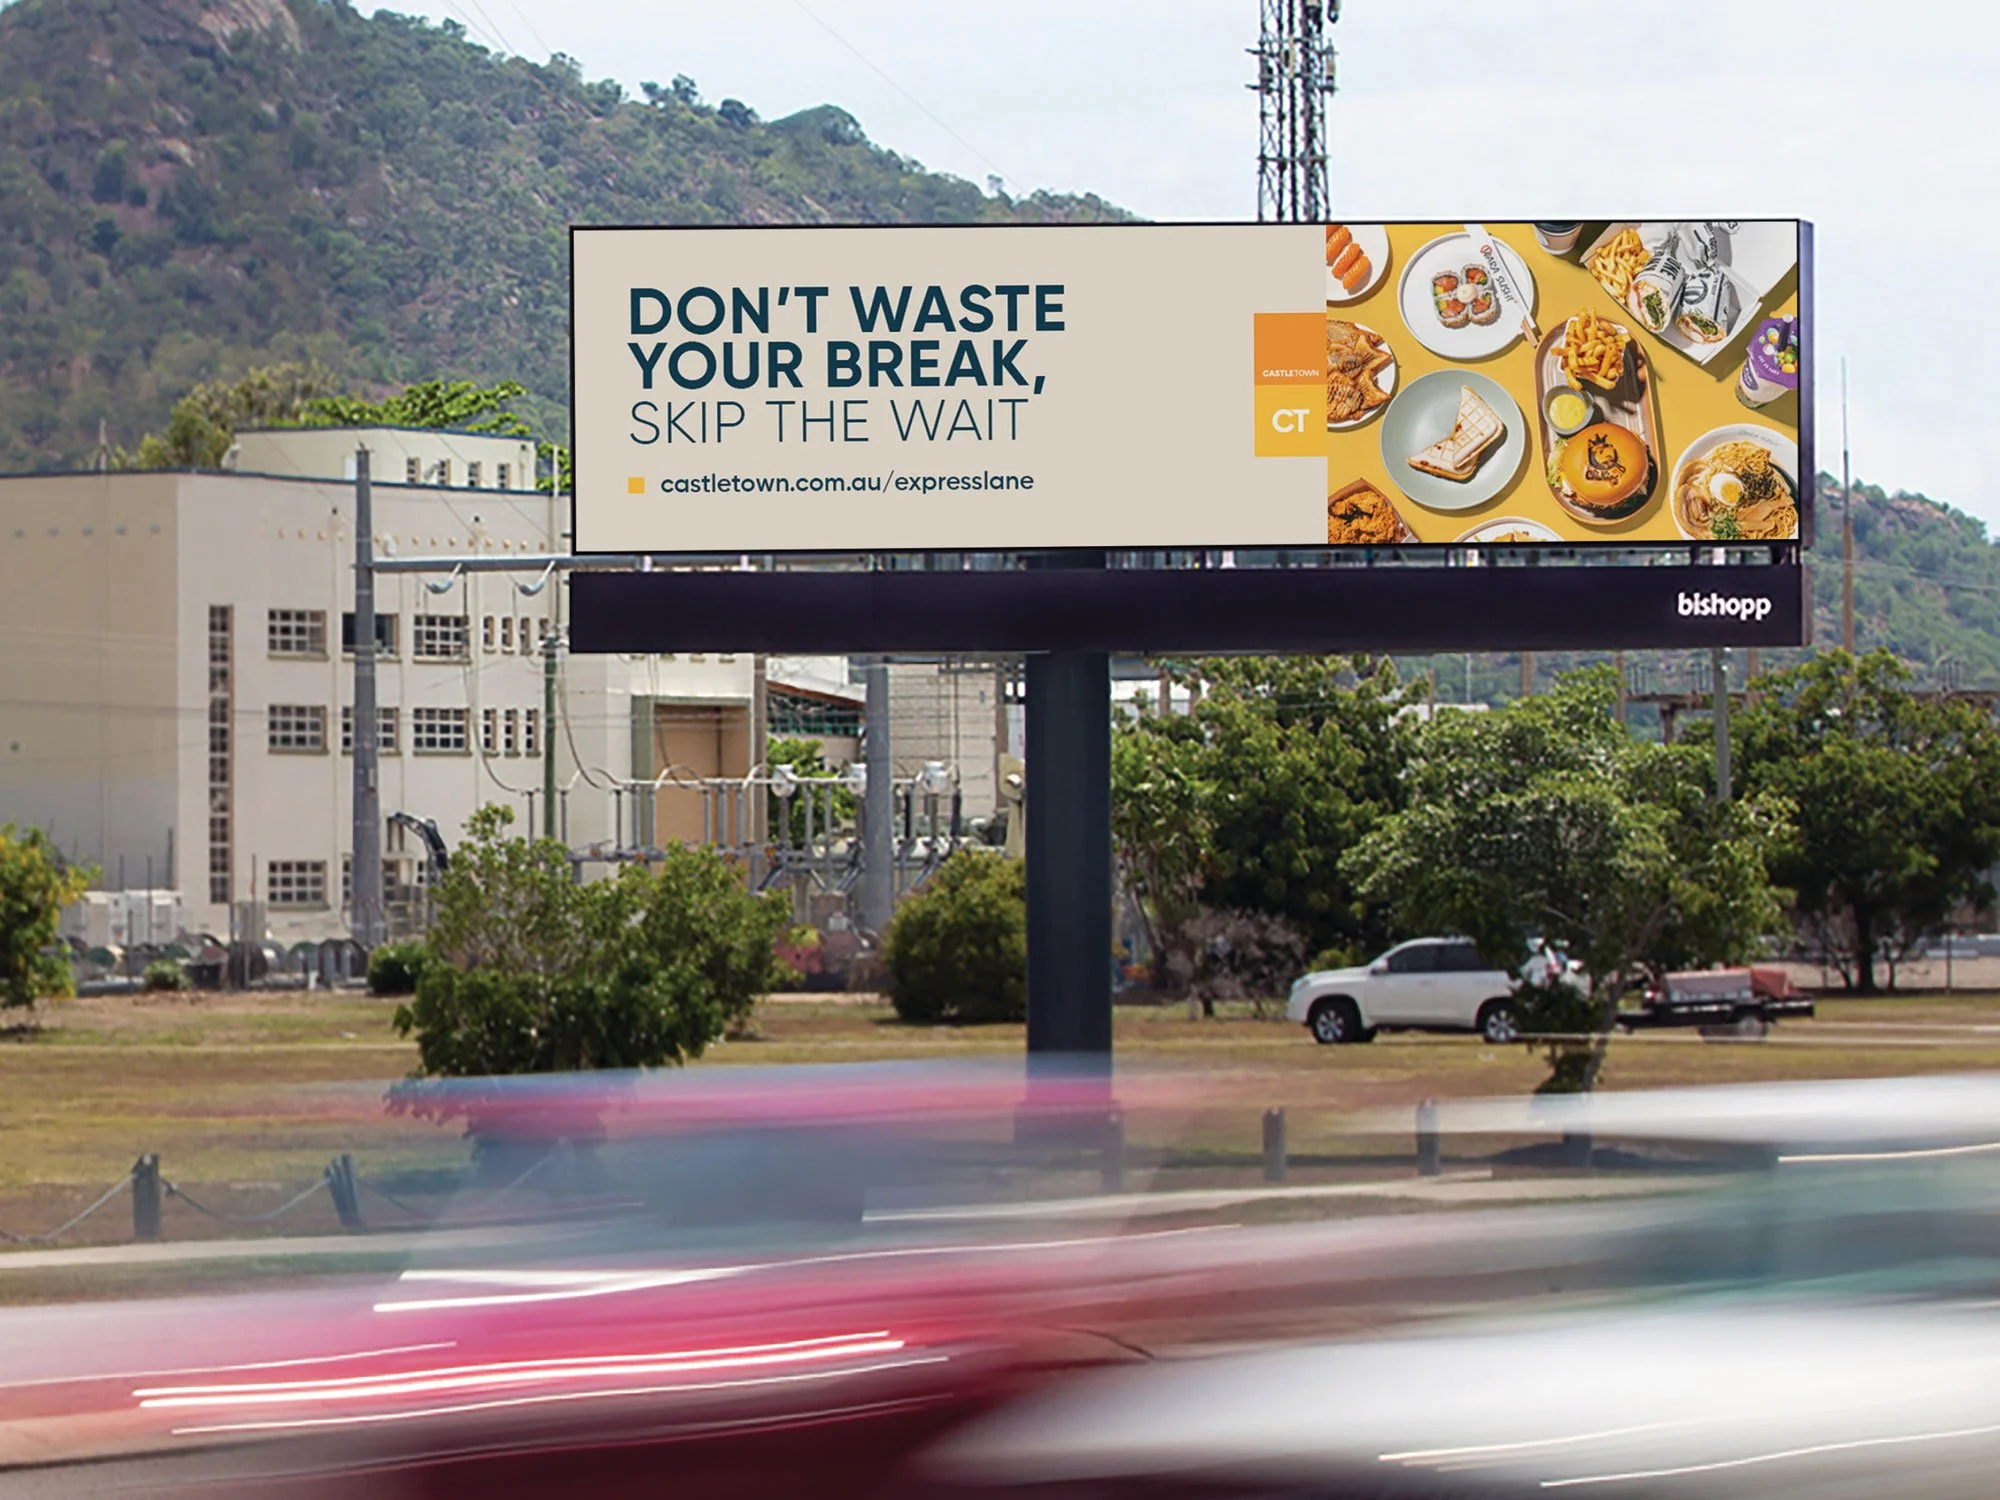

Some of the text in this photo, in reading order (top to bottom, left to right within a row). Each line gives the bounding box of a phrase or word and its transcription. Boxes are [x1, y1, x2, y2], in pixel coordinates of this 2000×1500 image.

[630, 284, 1066, 335] DON'T WASTE
[627, 339, 1046, 394] YOUR BREAK,
[1262, 369, 1320, 378] CASTLETOWN
[630, 399, 1029, 445] SKIP THE WAIT
[1272, 408, 1311, 433] CT
[660, 470, 1035, 494] castletown.com.au/expresslane
[1677, 592, 1772, 621] bishopp
